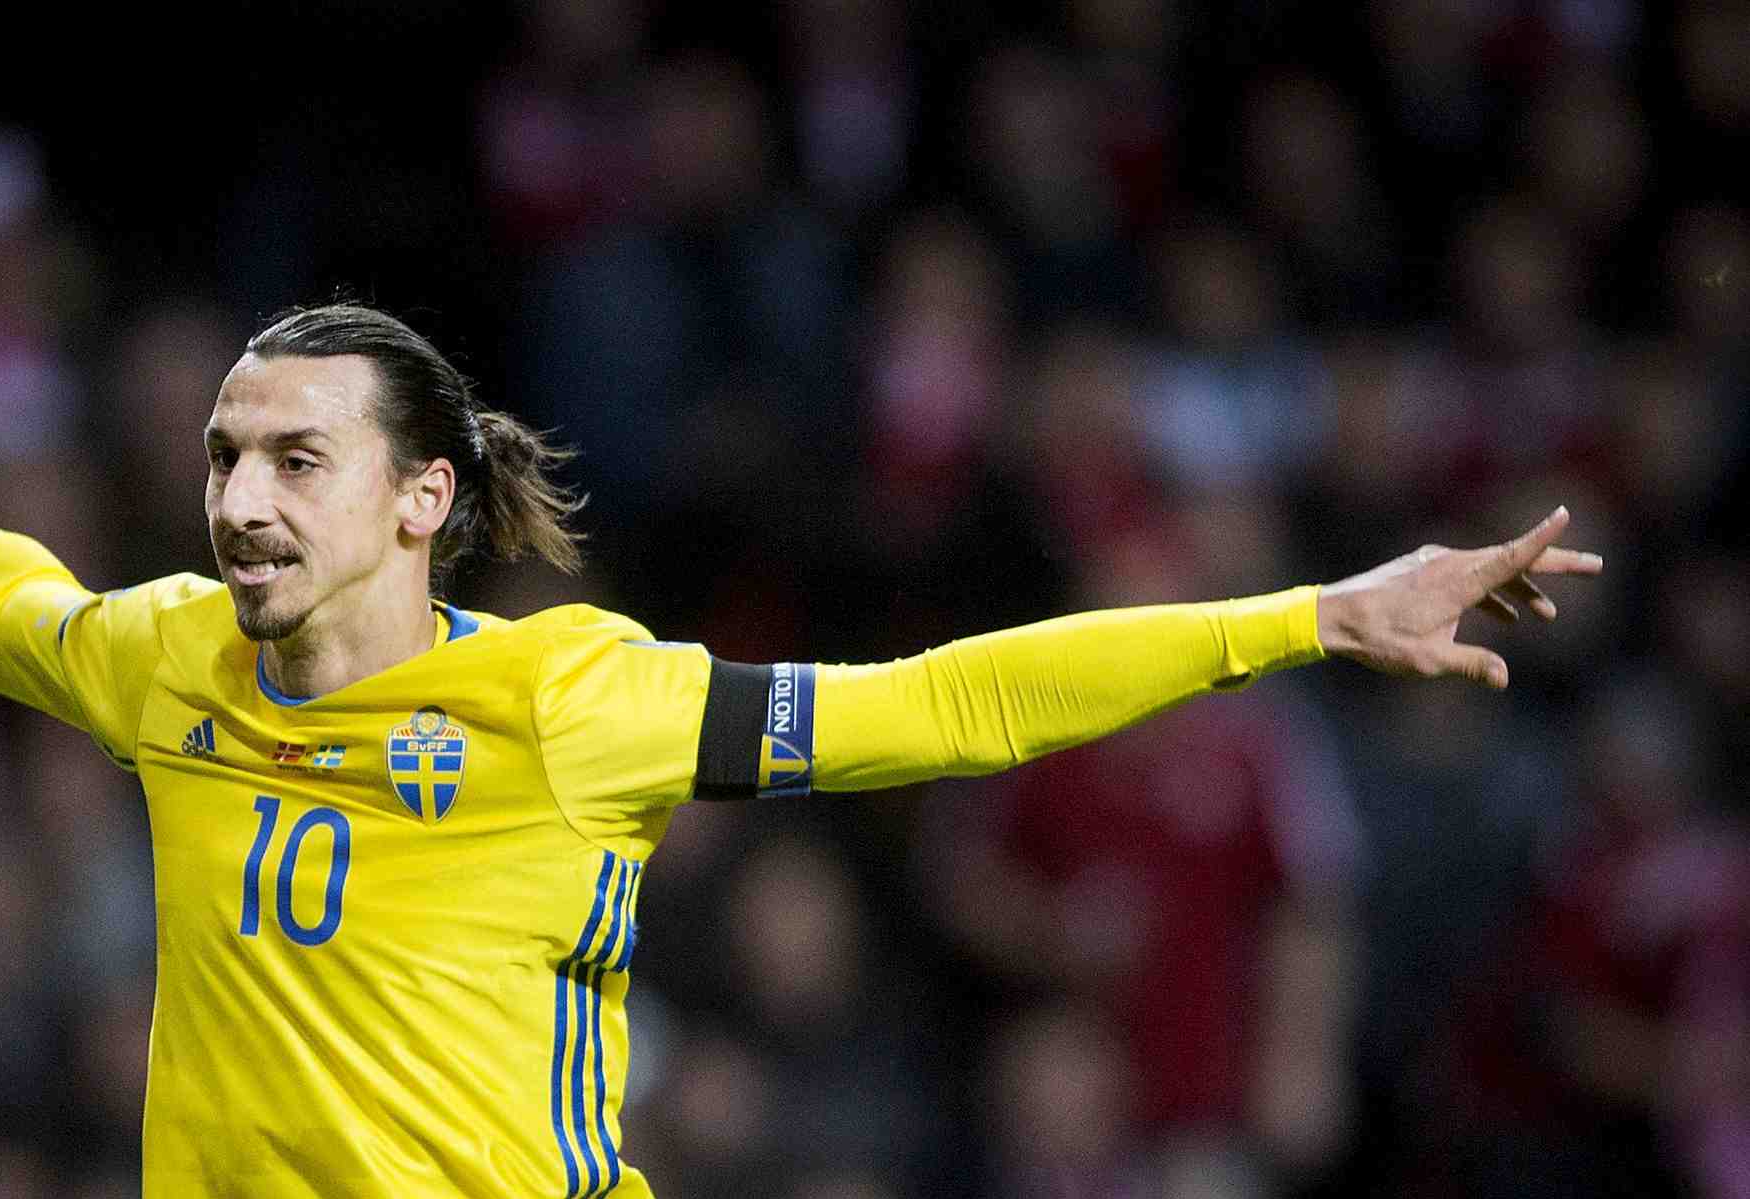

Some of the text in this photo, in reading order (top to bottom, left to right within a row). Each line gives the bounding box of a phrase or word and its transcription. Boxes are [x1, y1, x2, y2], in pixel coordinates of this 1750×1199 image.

[775, 678, 792, 701] TO
[774, 701, 791, 733] NO
[239, 794, 351, 947] 10
